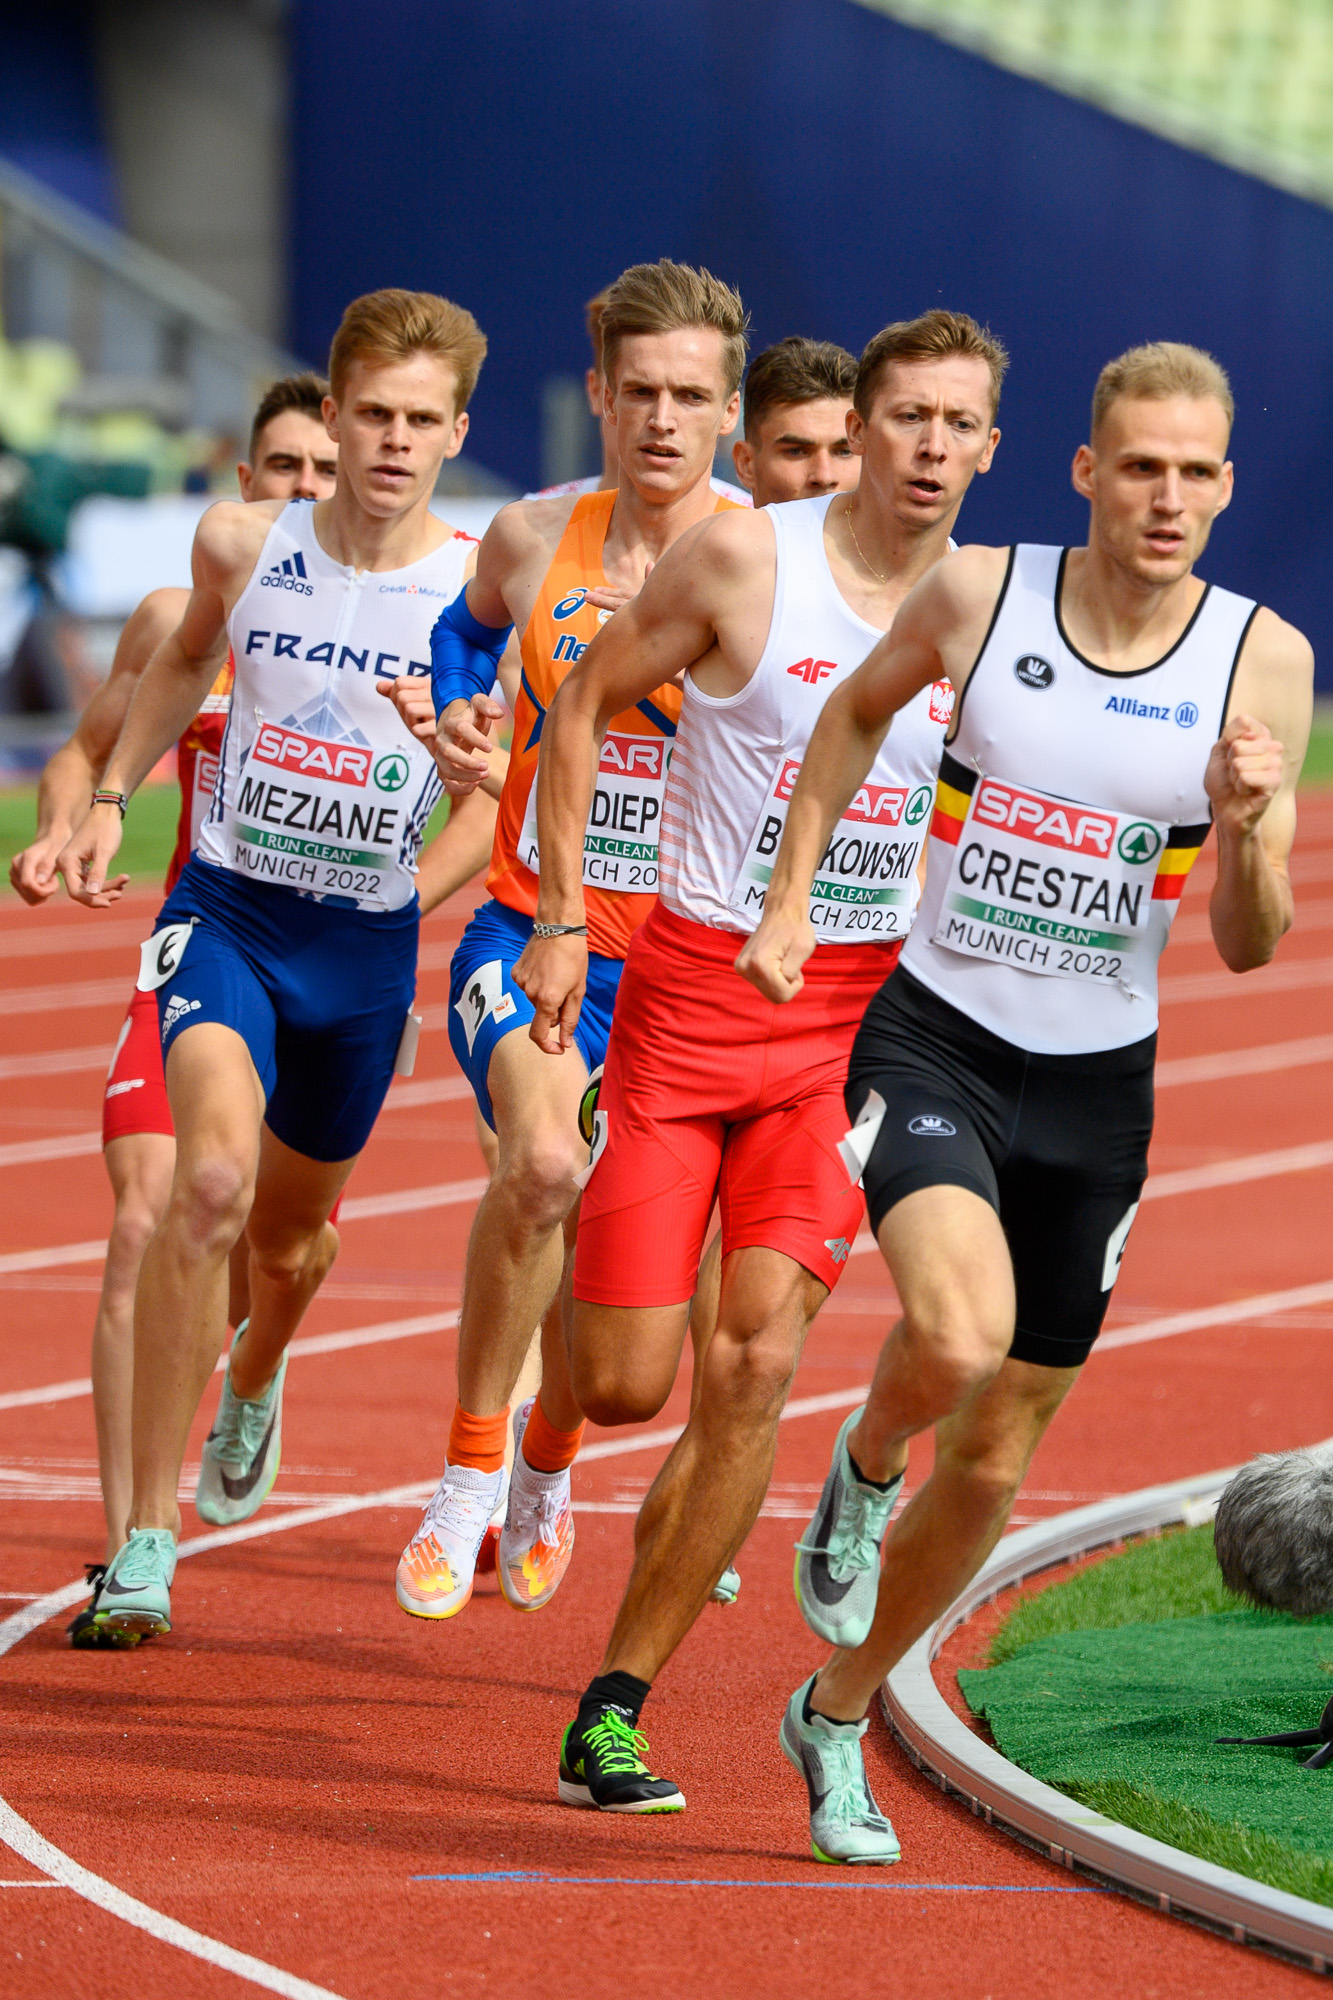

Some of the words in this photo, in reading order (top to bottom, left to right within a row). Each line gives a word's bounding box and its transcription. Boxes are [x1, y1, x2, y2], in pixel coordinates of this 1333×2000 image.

[260, 574, 314, 596] adidas
[787, 657, 838, 684] 4F
[1104, 695, 1171, 721] Allianz
[255, 727, 370, 783] SPAR
[600, 740, 660, 774] AR
[237, 776, 398, 844] MEZIANE
[780, 767, 905, 821] SAR
[258, 832, 265, 845] I
[267, 834, 300, 853] RUN
[976, 785, 1114, 853] SPAR
[235, 844, 317, 883] MUNICH
[324, 868, 381, 894] 2022
[756, 815, 919, 880] BKOWSKI
[628, 866, 658, 886] 20
[959, 842, 1143, 927] CRESTAN
[845, 909, 898, 932] 2022
[983, 906, 991, 920] I
[993, 909, 1032, 931] RUN
[946, 918, 1051, 966] MUNICH
[1057, 949, 1123, 978] 2022
[468, 982, 487, 1031] 3
